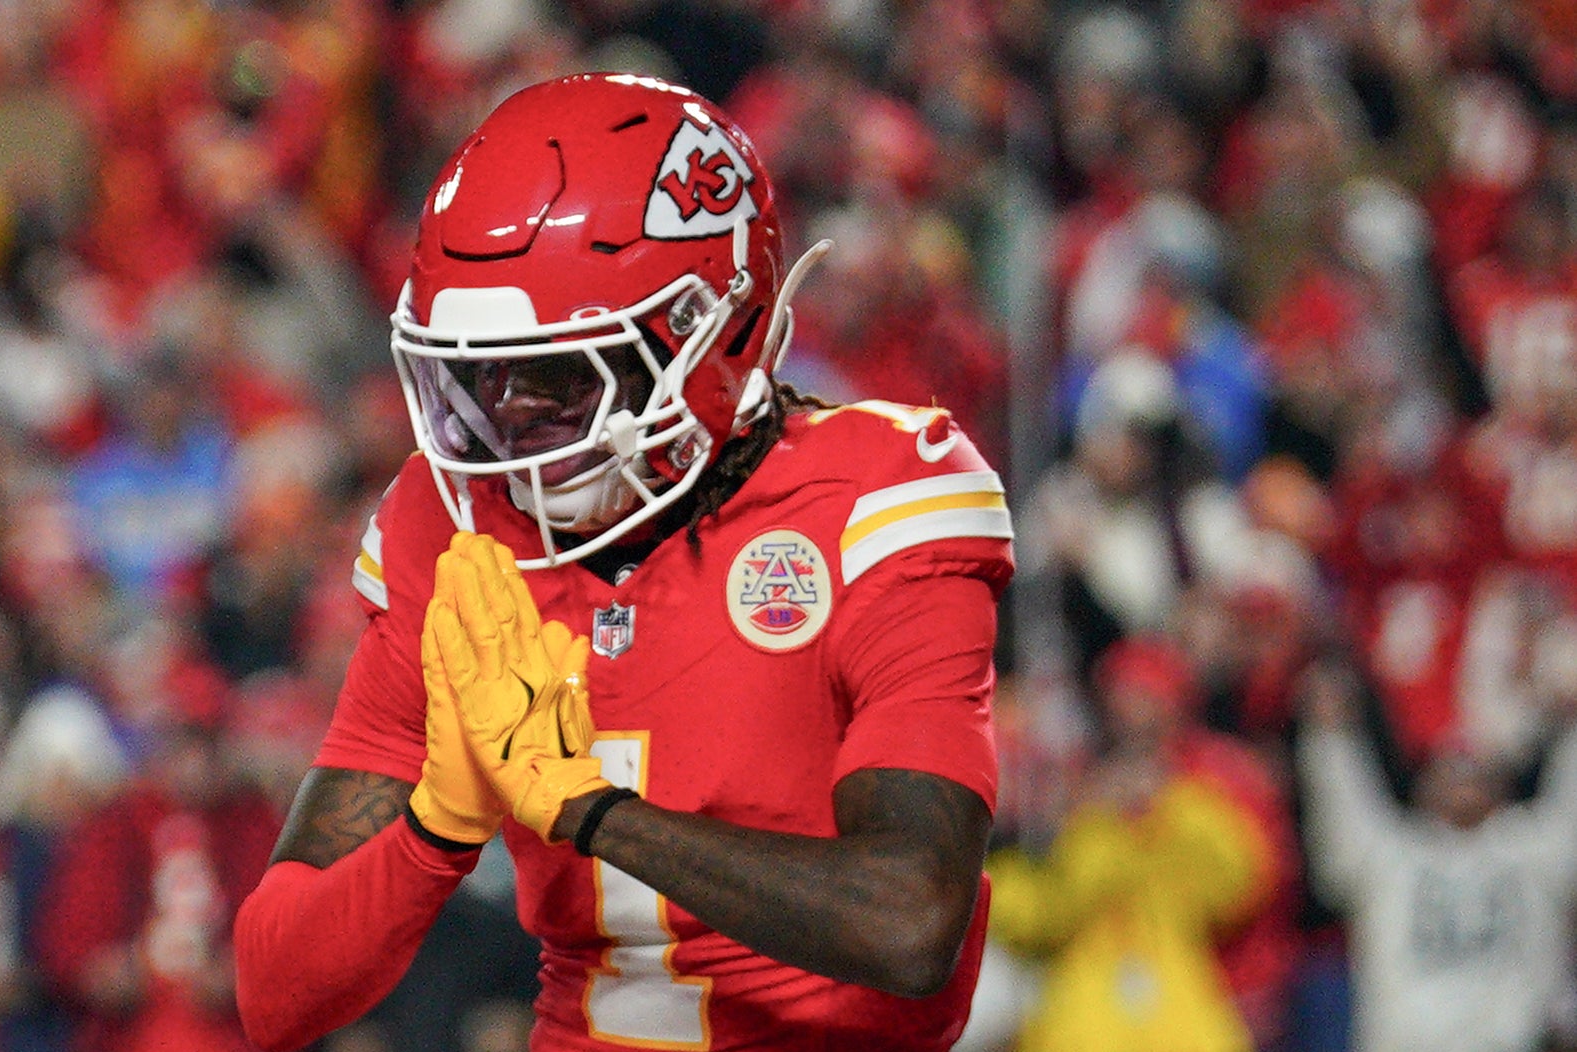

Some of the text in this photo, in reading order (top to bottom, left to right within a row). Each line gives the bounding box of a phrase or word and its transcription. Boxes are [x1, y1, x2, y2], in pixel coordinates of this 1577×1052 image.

[657, 147, 743, 224] KC
[599, 627, 627, 649] NFL
[582, 730, 712, 1052] 1
